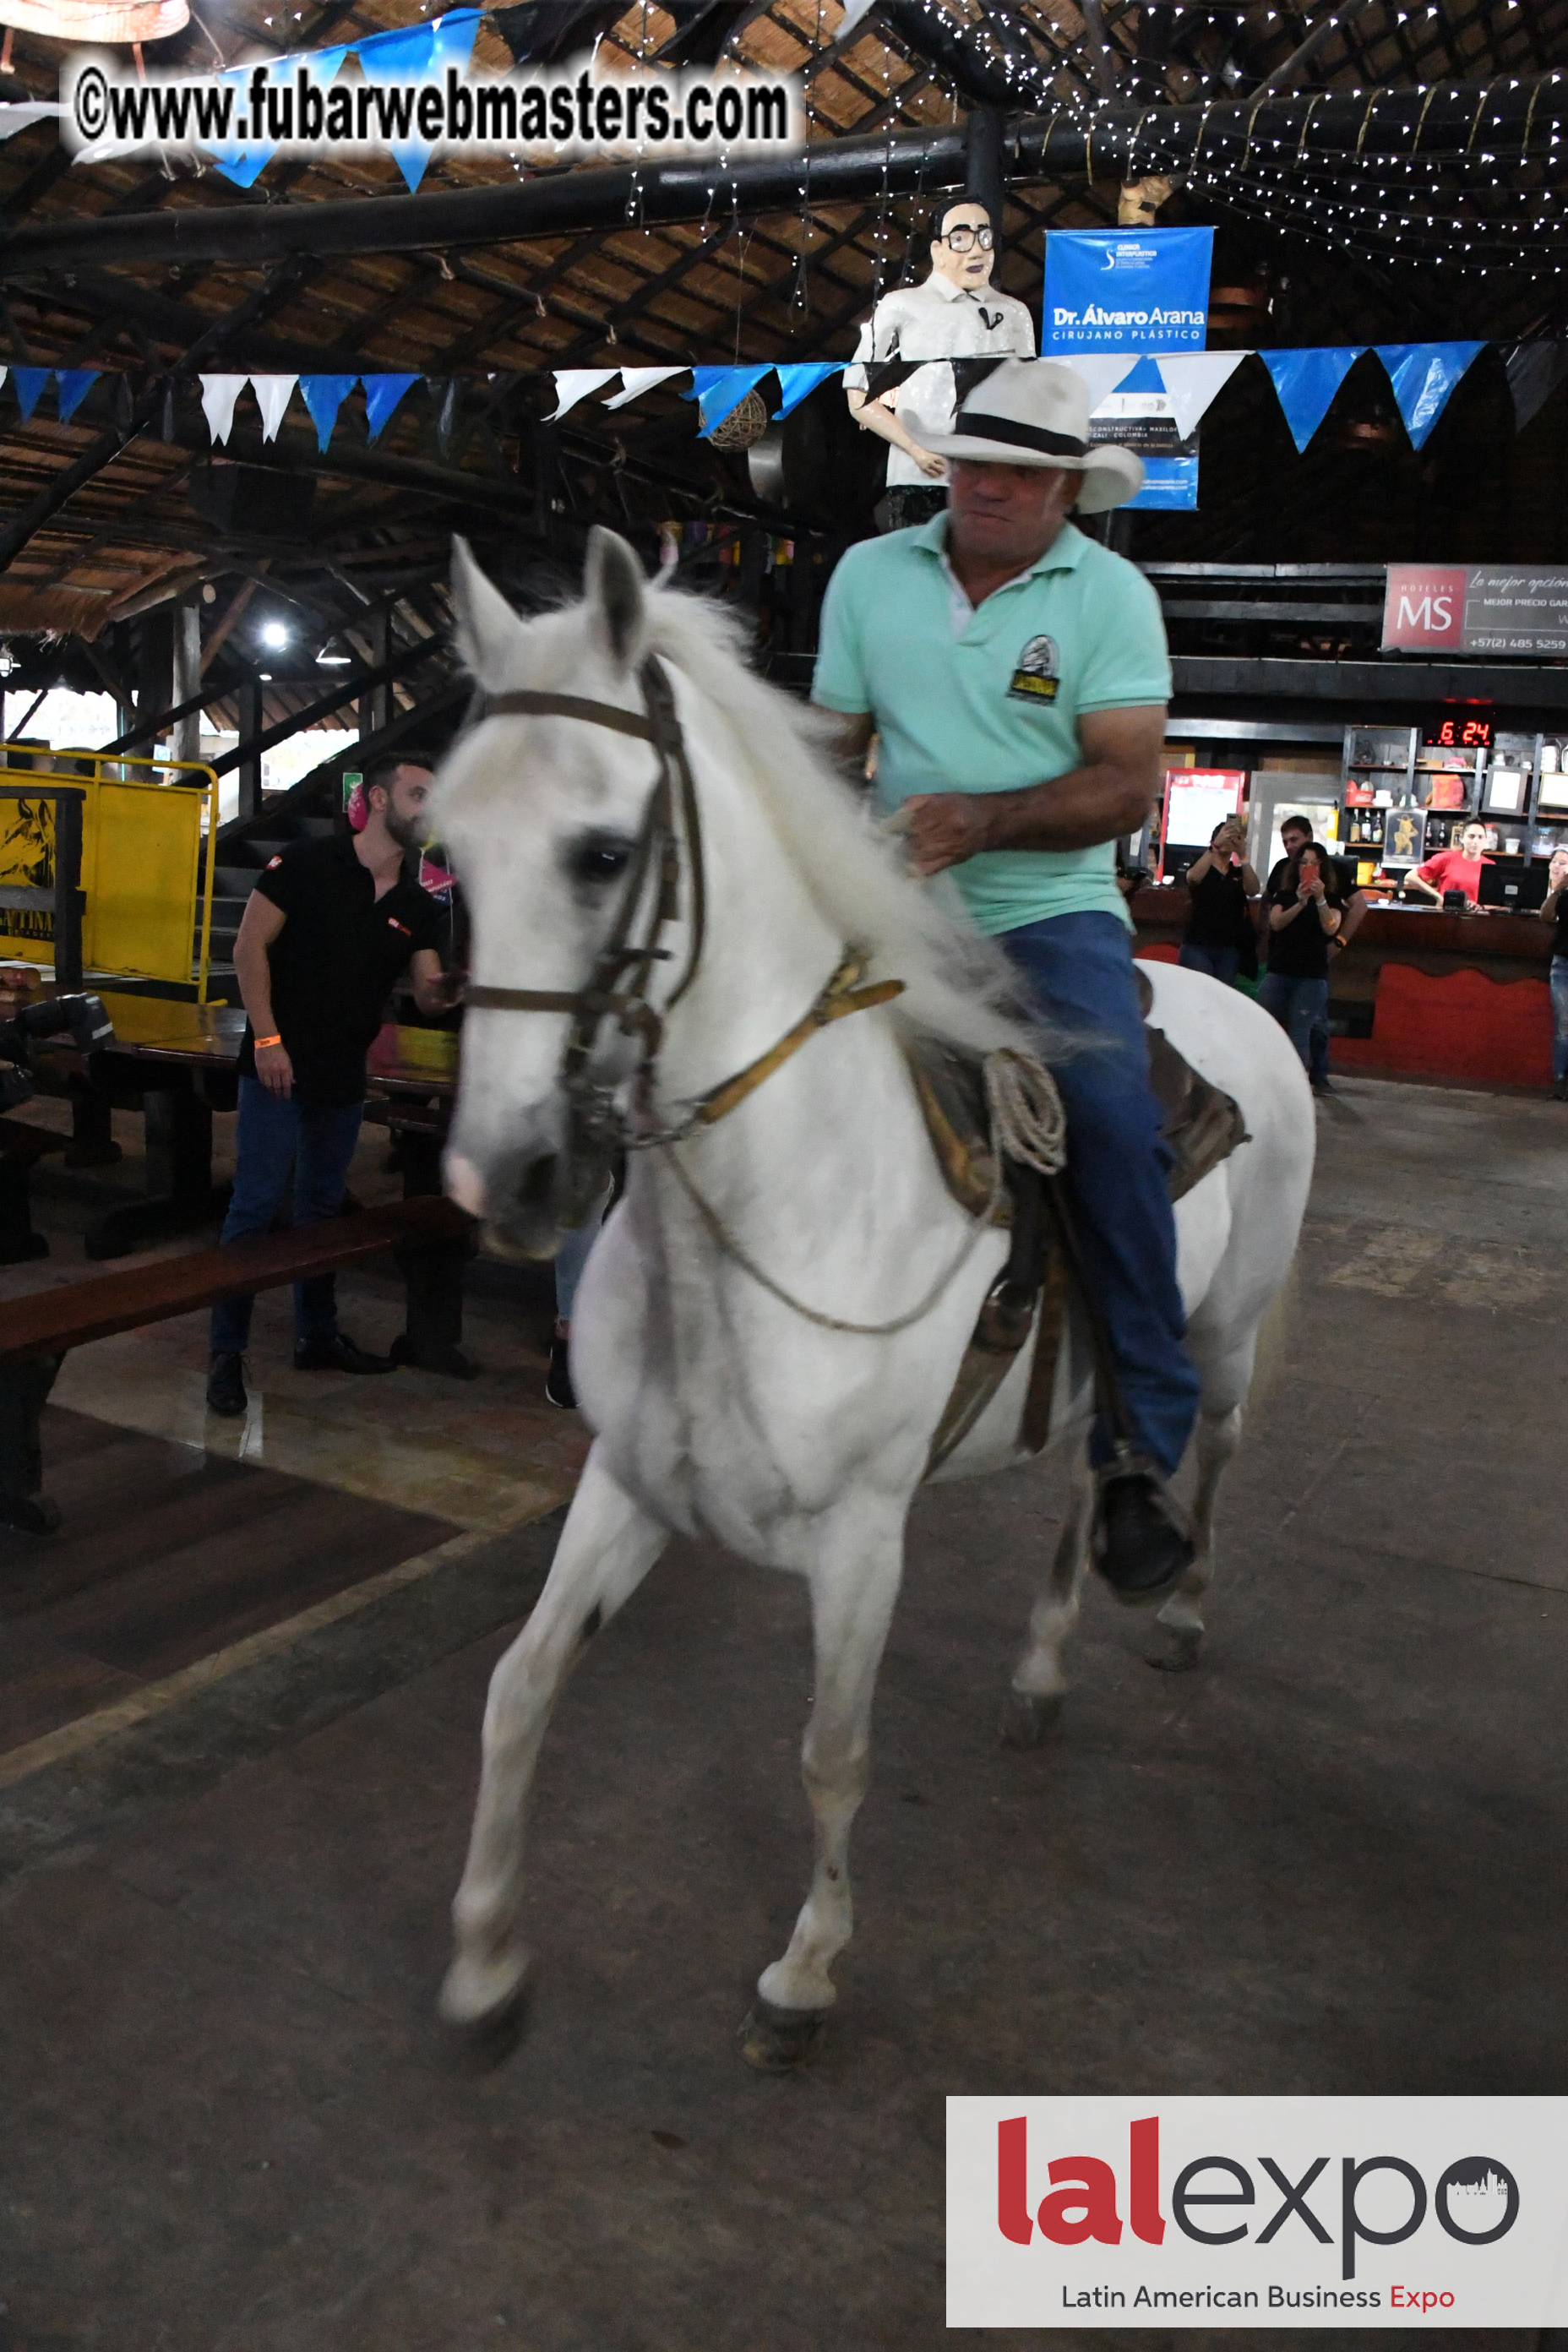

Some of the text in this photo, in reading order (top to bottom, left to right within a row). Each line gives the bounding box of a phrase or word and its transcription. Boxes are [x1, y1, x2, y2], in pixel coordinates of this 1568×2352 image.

[1054, 304, 1205, 326] Dr. Álvaro Arana
[1053, 329, 1200, 340] CIRUJANO PLÁSTICO
[1468, 570, 1485, 589] La
[1488, 576, 1525, 593] mejor
[1515, 598, 1547, 607] PRECIO
[1549, 599, 1568, 607] GAR
[1396, 596, 1452, 631] MS
[1470, 638, 1505, 649] +57(2)
[1510, 639, 1533, 648] 485
[1536, 640, 1566, 650] 5259
